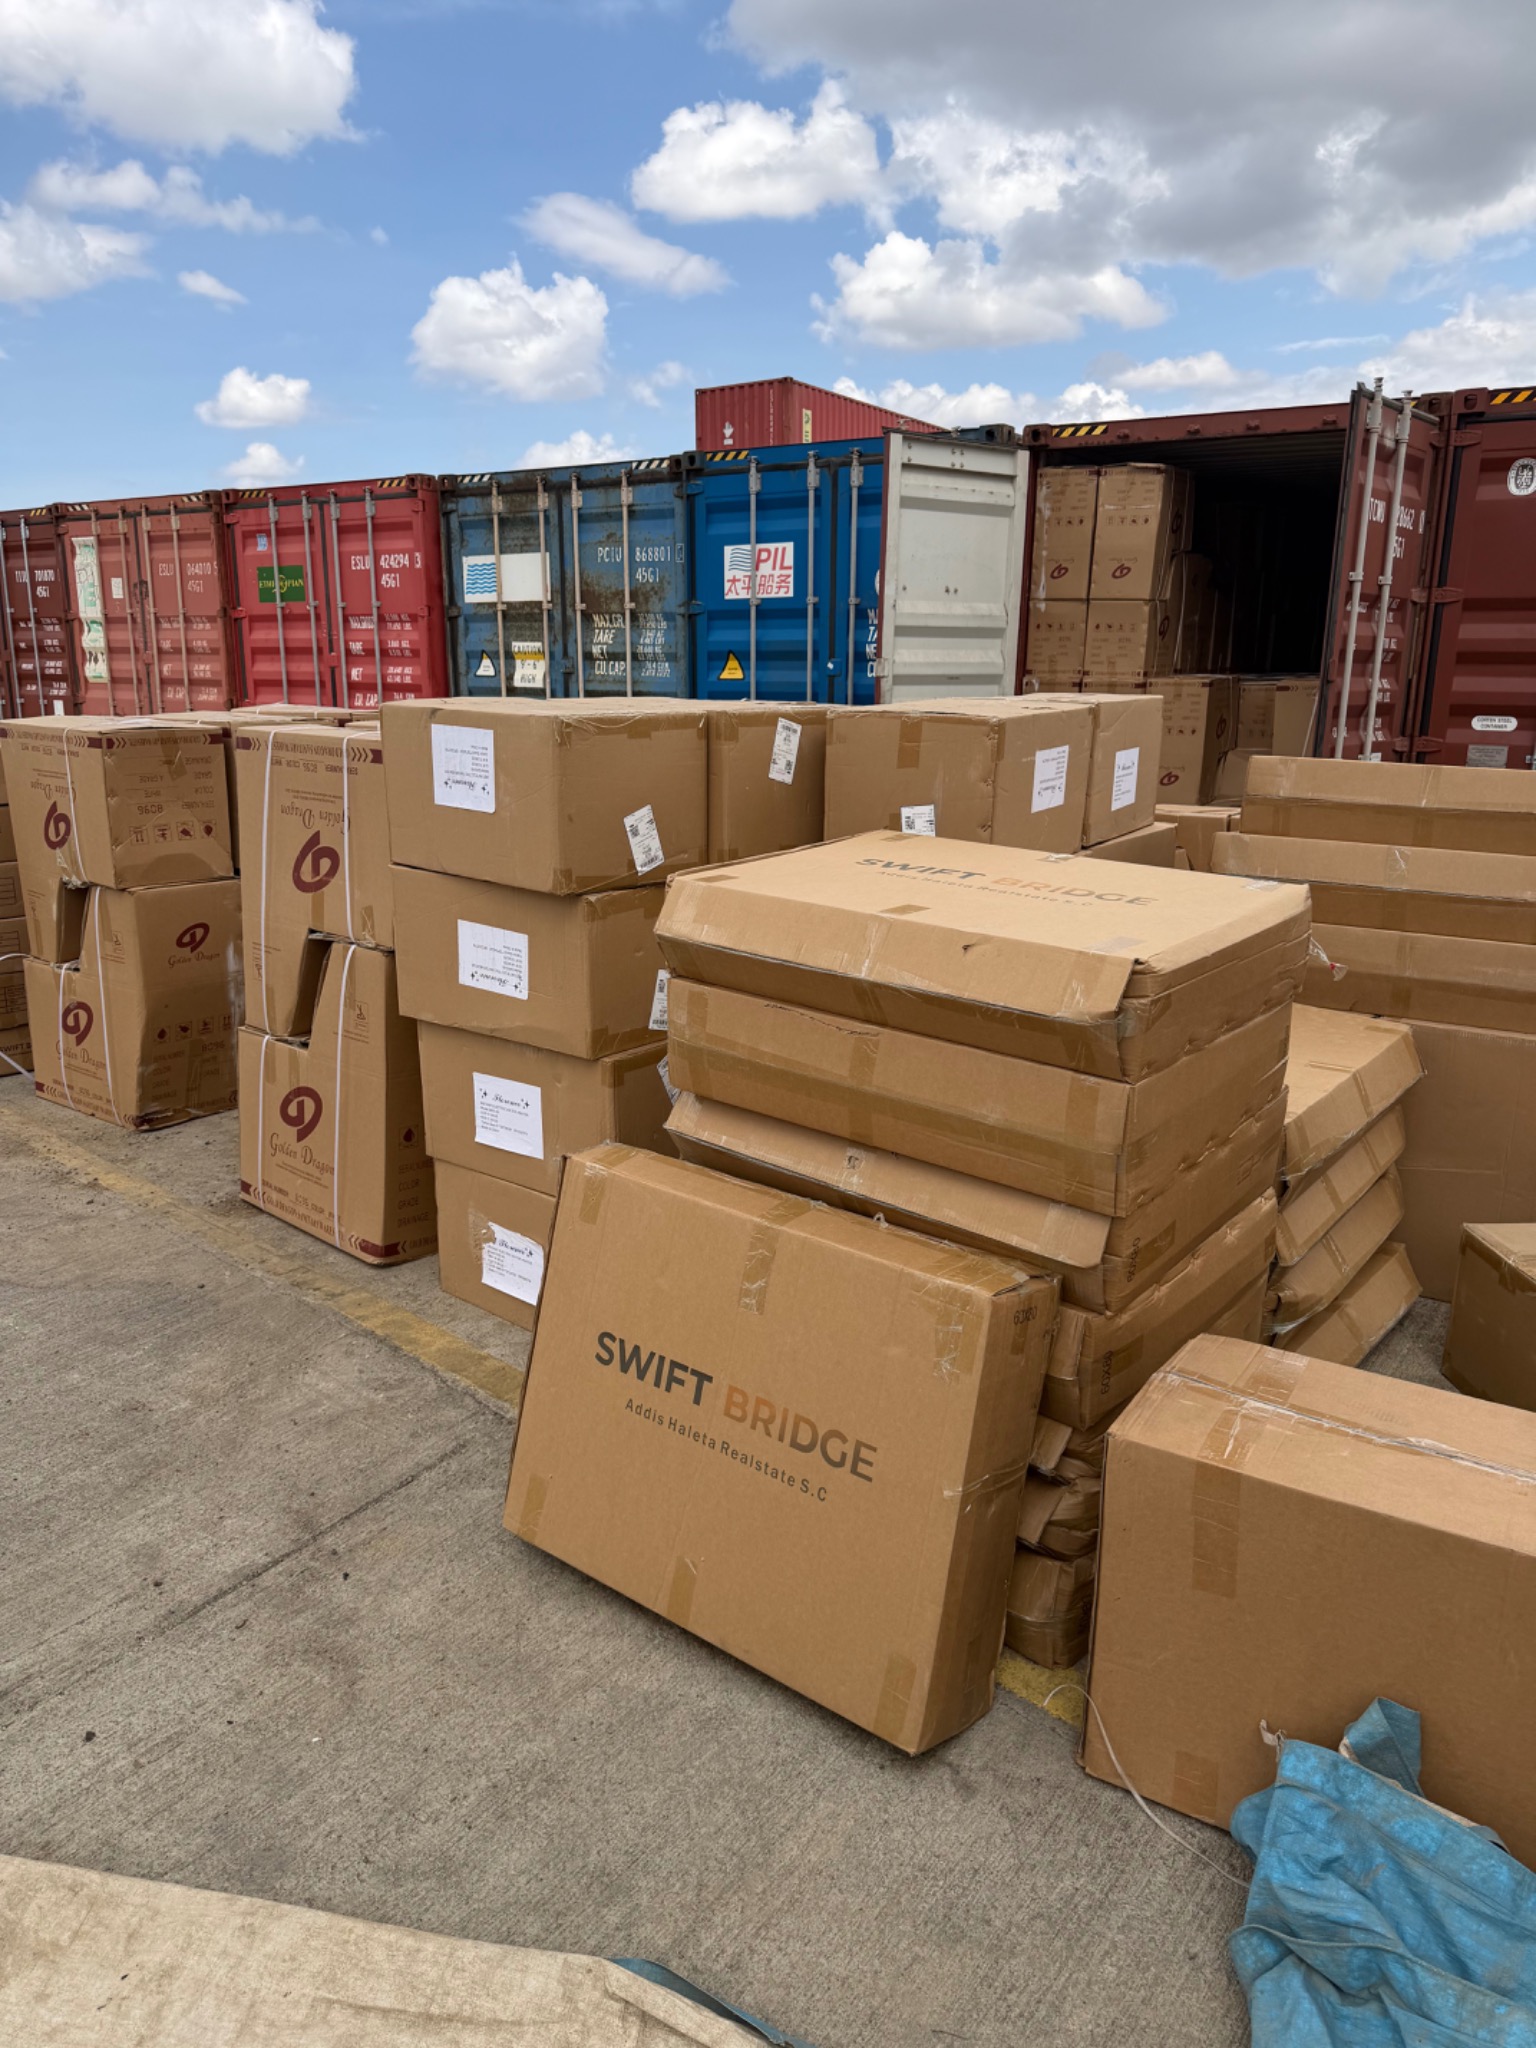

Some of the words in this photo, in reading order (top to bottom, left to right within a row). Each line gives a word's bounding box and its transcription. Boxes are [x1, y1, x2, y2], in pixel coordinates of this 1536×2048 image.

[351, 556, 371, 570] ESLU
[380, 554, 410, 569] 424294
[597, 547, 622, 562] PCIU
[635, 546, 671, 562] 868801
[755, 547, 793, 572] PIL
[381, 573, 401, 588] 45G1
[635, 568, 660, 582] 45G1
[593, 629, 616, 644] TARE
[592, 645, 608, 660] NET
[280, 801, 316, 830] Dragon
[855, 857, 987, 880] SWIFT
[990, 876, 1159, 907] BRIDGE
[269, 1131, 299, 1159] Golden
[300, 1144, 336, 1176] Dragon
[594, 1330, 714, 1407] SWIFT
[722, 1383, 879, 1484] BRIDGE
[624, 1397, 664, 1427] Addis
[667, 1416, 716, 1451] Haleta
[719, 1440, 797, 1488] Realstate
[799, 1477, 828, 1503] S.C
